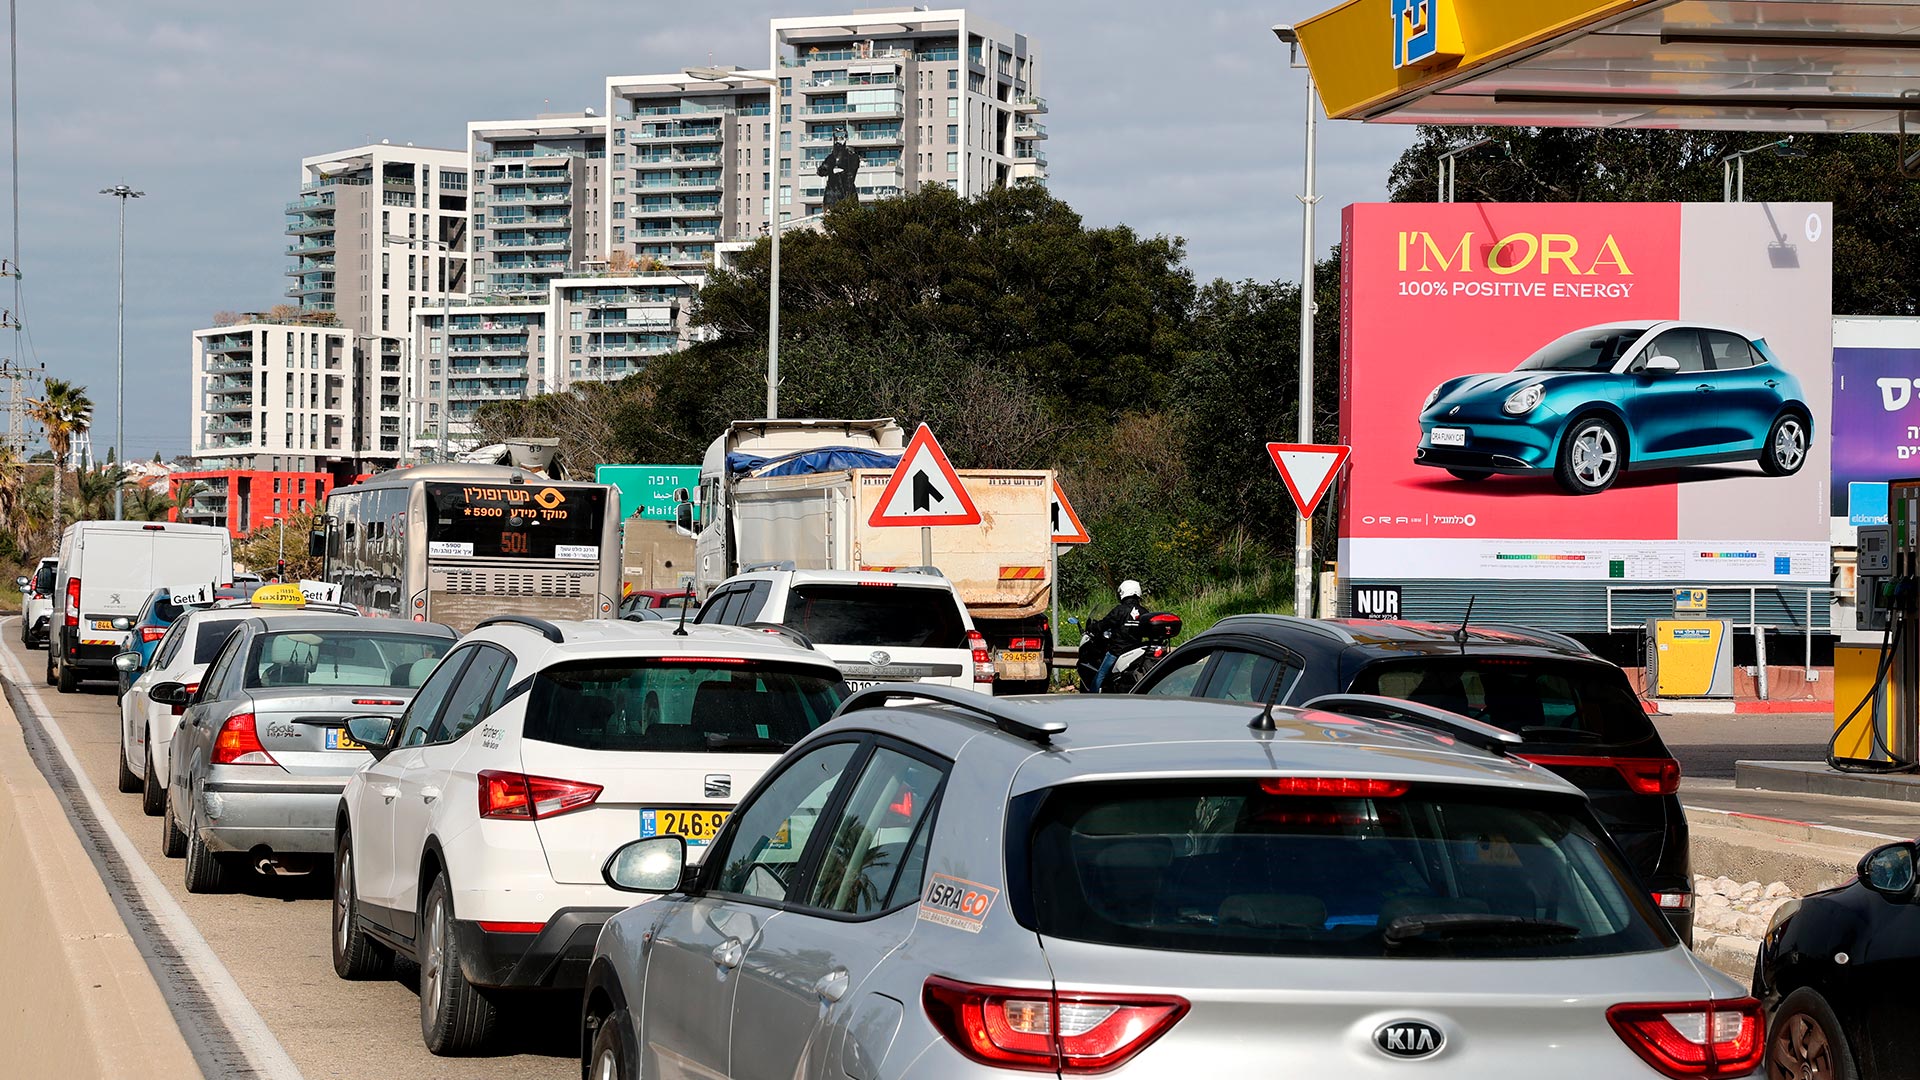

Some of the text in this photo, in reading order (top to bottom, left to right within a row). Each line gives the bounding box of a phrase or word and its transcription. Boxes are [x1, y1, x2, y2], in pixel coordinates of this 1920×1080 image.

[1487, 232, 1635, 276] ORA
[1398, 281, 1634, 298] 100% POSITIVE ENERGY
[648, 475, 679, 486] חיפה
[463, 487, 530, 503] מטרופולין
[653, 490, 673, 501] حيفا
[510, 508, 537, 519] מידע
[540, 509, 568, 521] מוקד
[647, 505, 677, 515] Haifa
[1362, 515, 1409, 524] ORA
[1851, 514, 1874, 523] eldan
[501, 532, 529, 553] 501
[174, 593, 195, 605] Gett
[302, 589, 323, 601] Gett
[1357, 590, 1398, 613] NUR
[644, 819, 654, 831] IL
[927, 882, 989, 916] ISRACO
[1386, 1027, 1435, 1050] KIA
